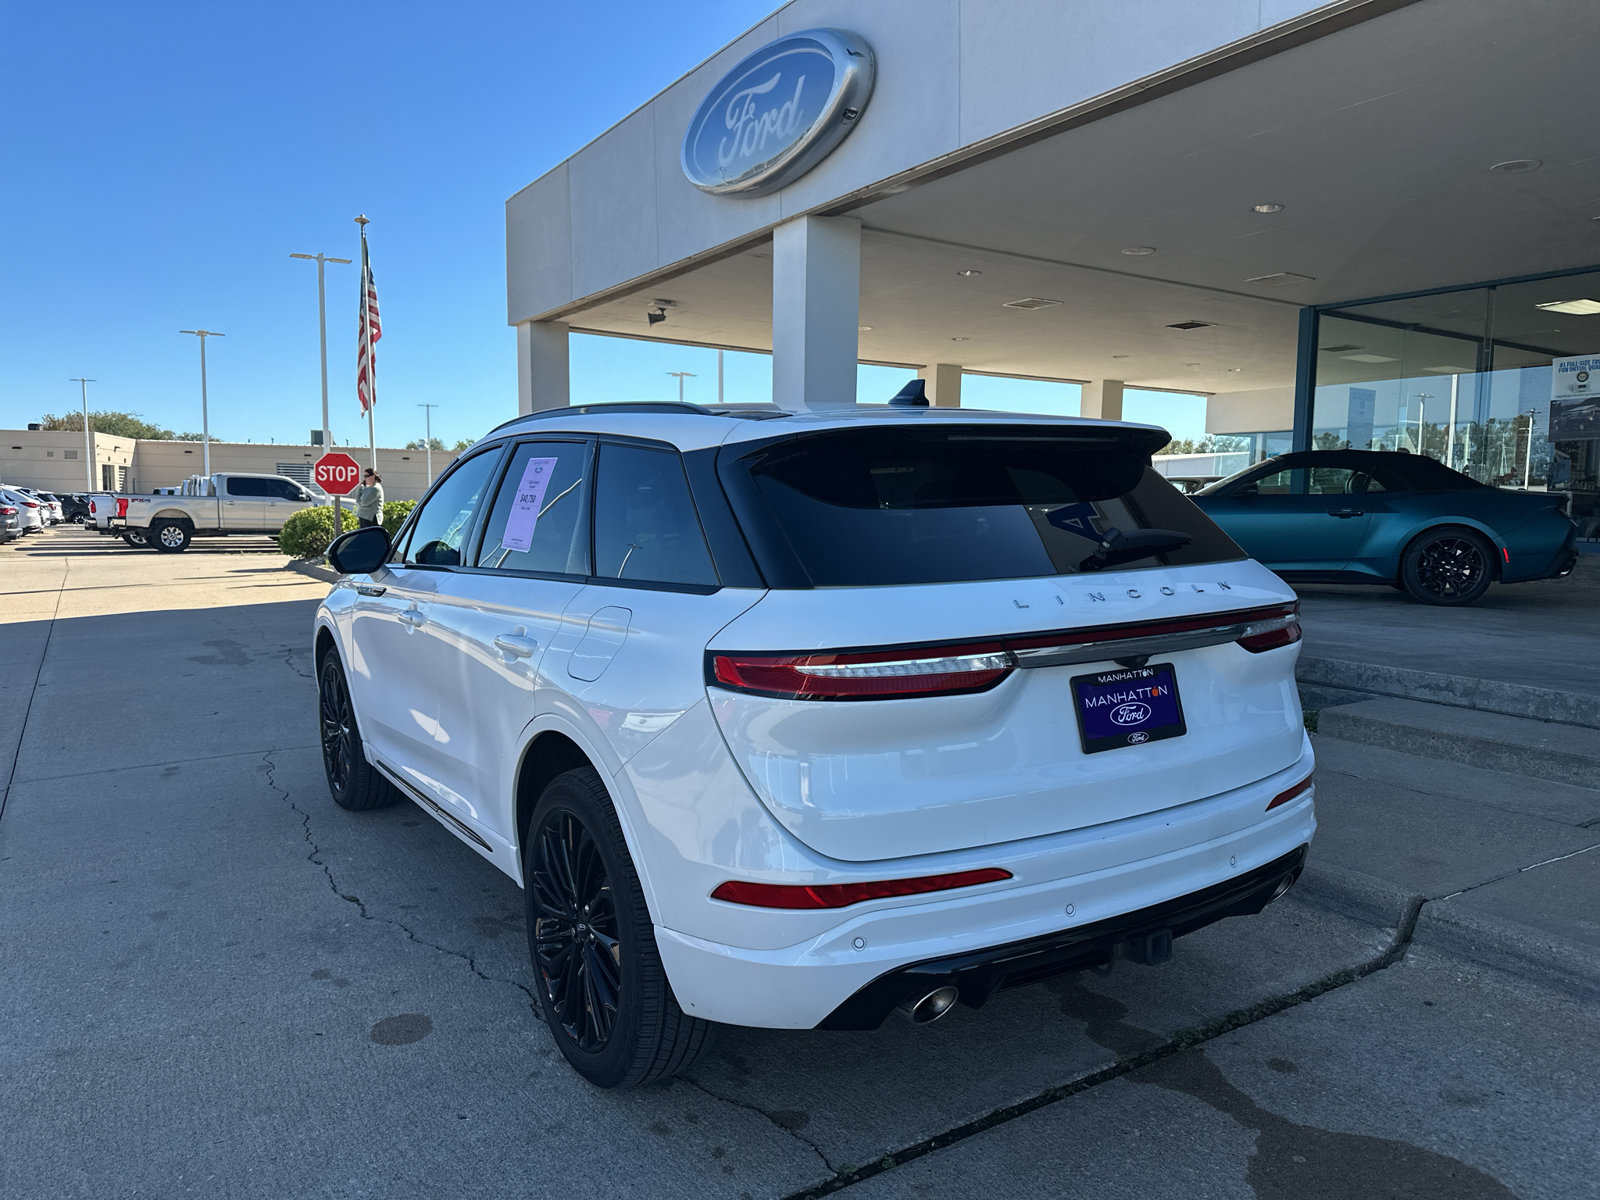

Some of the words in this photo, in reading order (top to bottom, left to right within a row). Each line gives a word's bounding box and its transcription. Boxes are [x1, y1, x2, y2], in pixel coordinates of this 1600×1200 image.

[719, 72, 806, 168] Ford
[317, 465, 357, 482] STOP
[1013, 580, 1232, 609] LINCOLN
[1117, 705, 1145, 723] Ford
